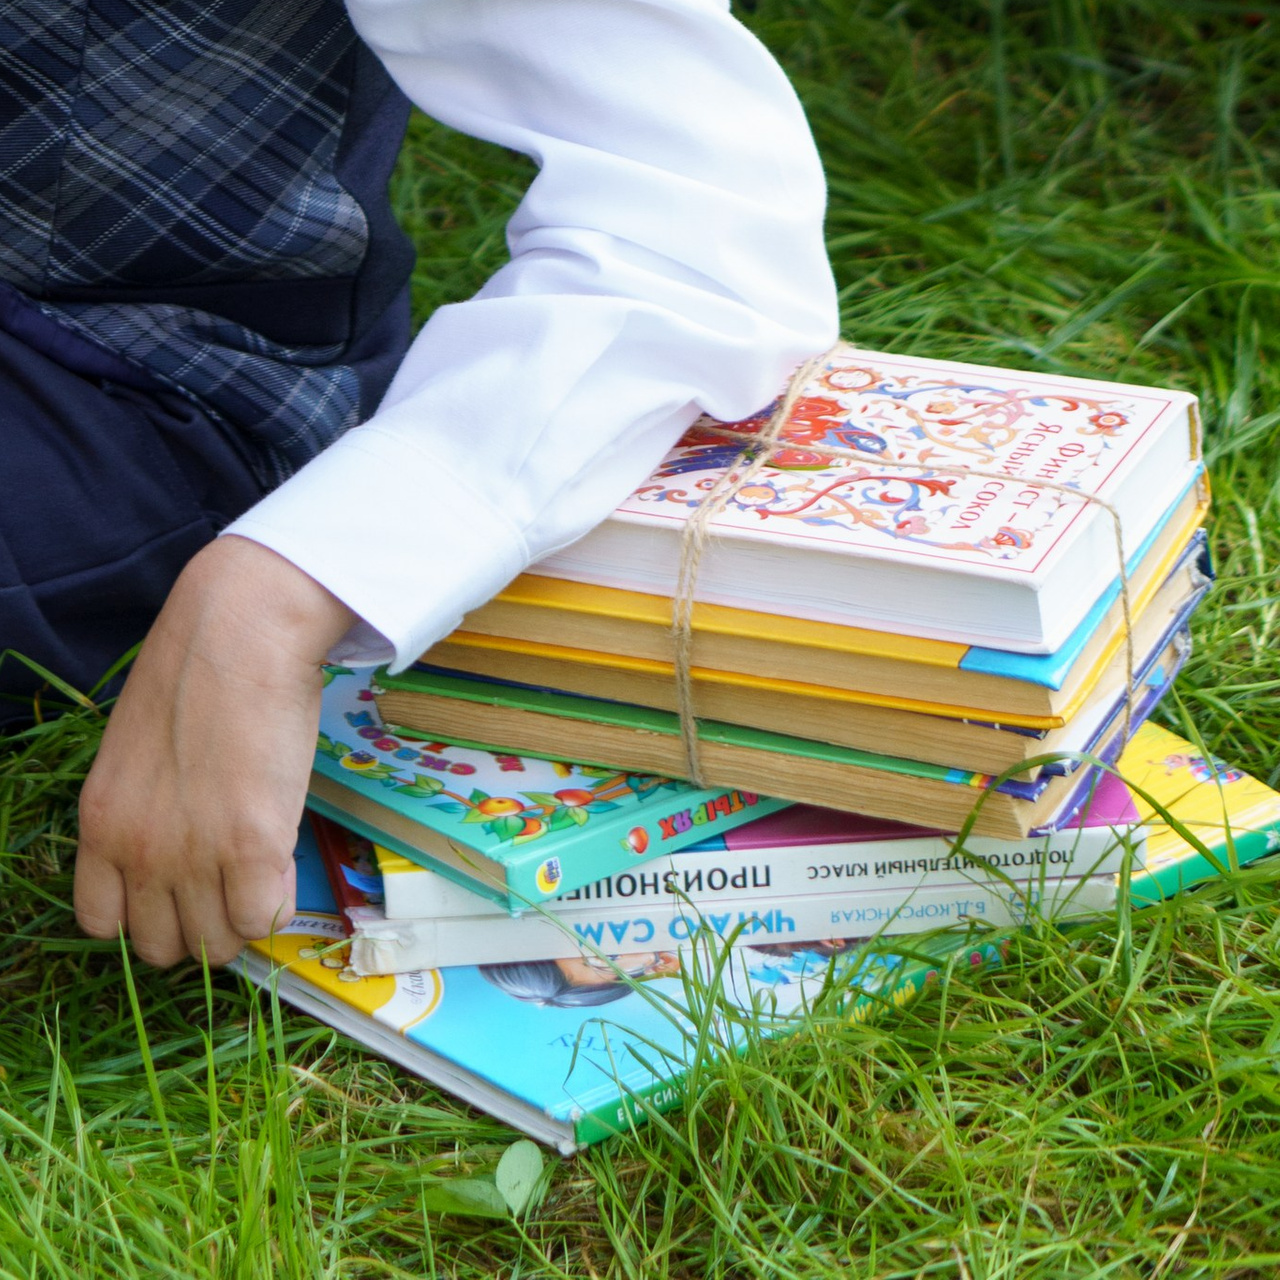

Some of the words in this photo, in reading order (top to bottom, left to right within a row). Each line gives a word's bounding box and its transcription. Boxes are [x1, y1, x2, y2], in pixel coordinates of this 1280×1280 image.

[658, 790, 768, 839] АТЫРЯХ
[807, 862, 867, 881] КЛАСС
[875, 849, 1076, 878] ПОДГОТОВИТЕЛЬНЫЙ
[574, 919, 655, 947] САМ
[669, 910, 796, 942] ЧИТАЮ
